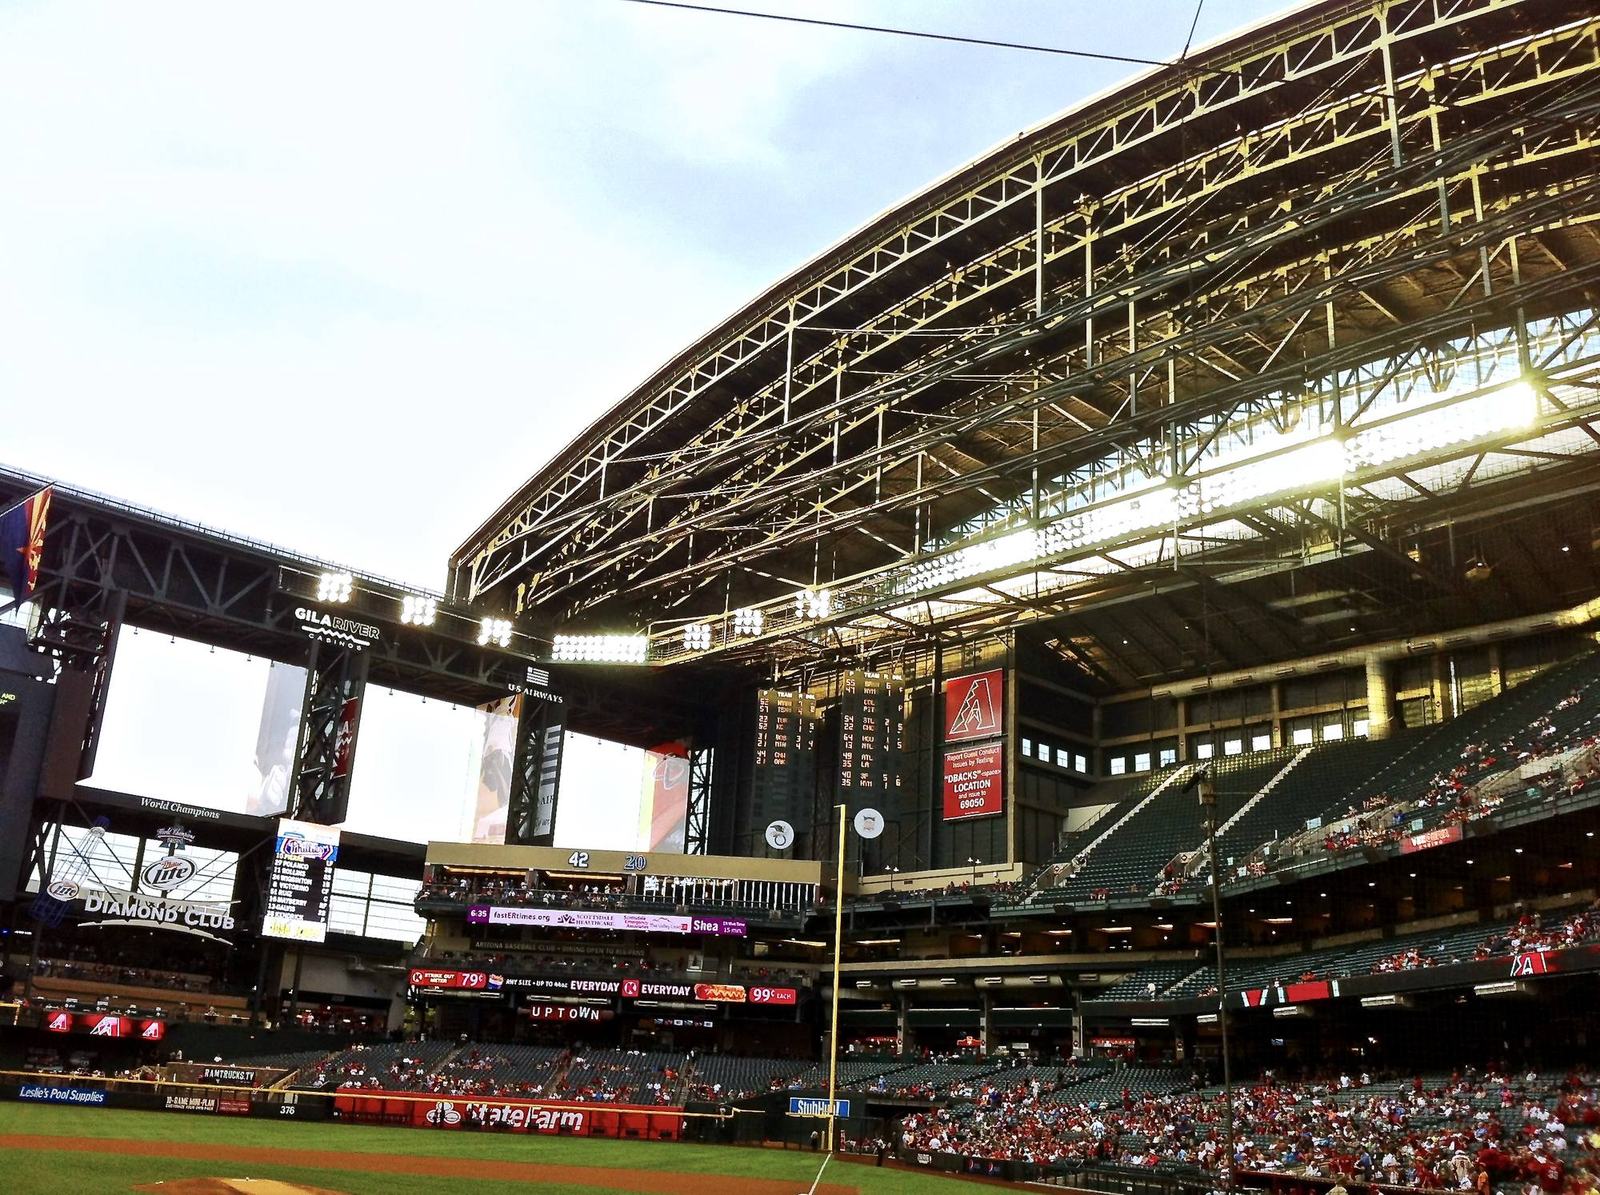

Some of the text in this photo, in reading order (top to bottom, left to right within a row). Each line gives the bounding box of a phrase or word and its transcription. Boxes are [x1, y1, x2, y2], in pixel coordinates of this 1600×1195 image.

[295, 608, 380, 640] GILA RIVER
[308, 634, 362, 650] CASINOS
[524, 688, 563, 704] AIRWAYS
[979, 747, 999, 756] Conduct
[954, 779, 991, 793] LOCATION
[141, 798, 220, 819] World Champions
[960, 798, 984, 809] 69050
[283, 861, 309, 870] POLANCO
[568, 852, 646, 870] 42 20
[152, 867, 188, 884] Lite
[282, 868, 306, 877] ROLLINS
[280, 882, 309, 892] VICTORINO
[85, 894, 235, 929] DIAMOND CLUB
[470, 910, 550, 922] 6:35 fastERtimes.org
[693, 920, 718, 931] Shea
[570, 980, 620, 992] EVERYDAY
[641, 984, 691, 996] EVERYDAY
[204, 1069, 255, 1081] RAMTRUCKS.TV
[20, 1086, 104, 1102] Leslie's Pool Supplies
[280, 1106, 295, 1115] 376
[530, 1106, 583, 1130] Farm
